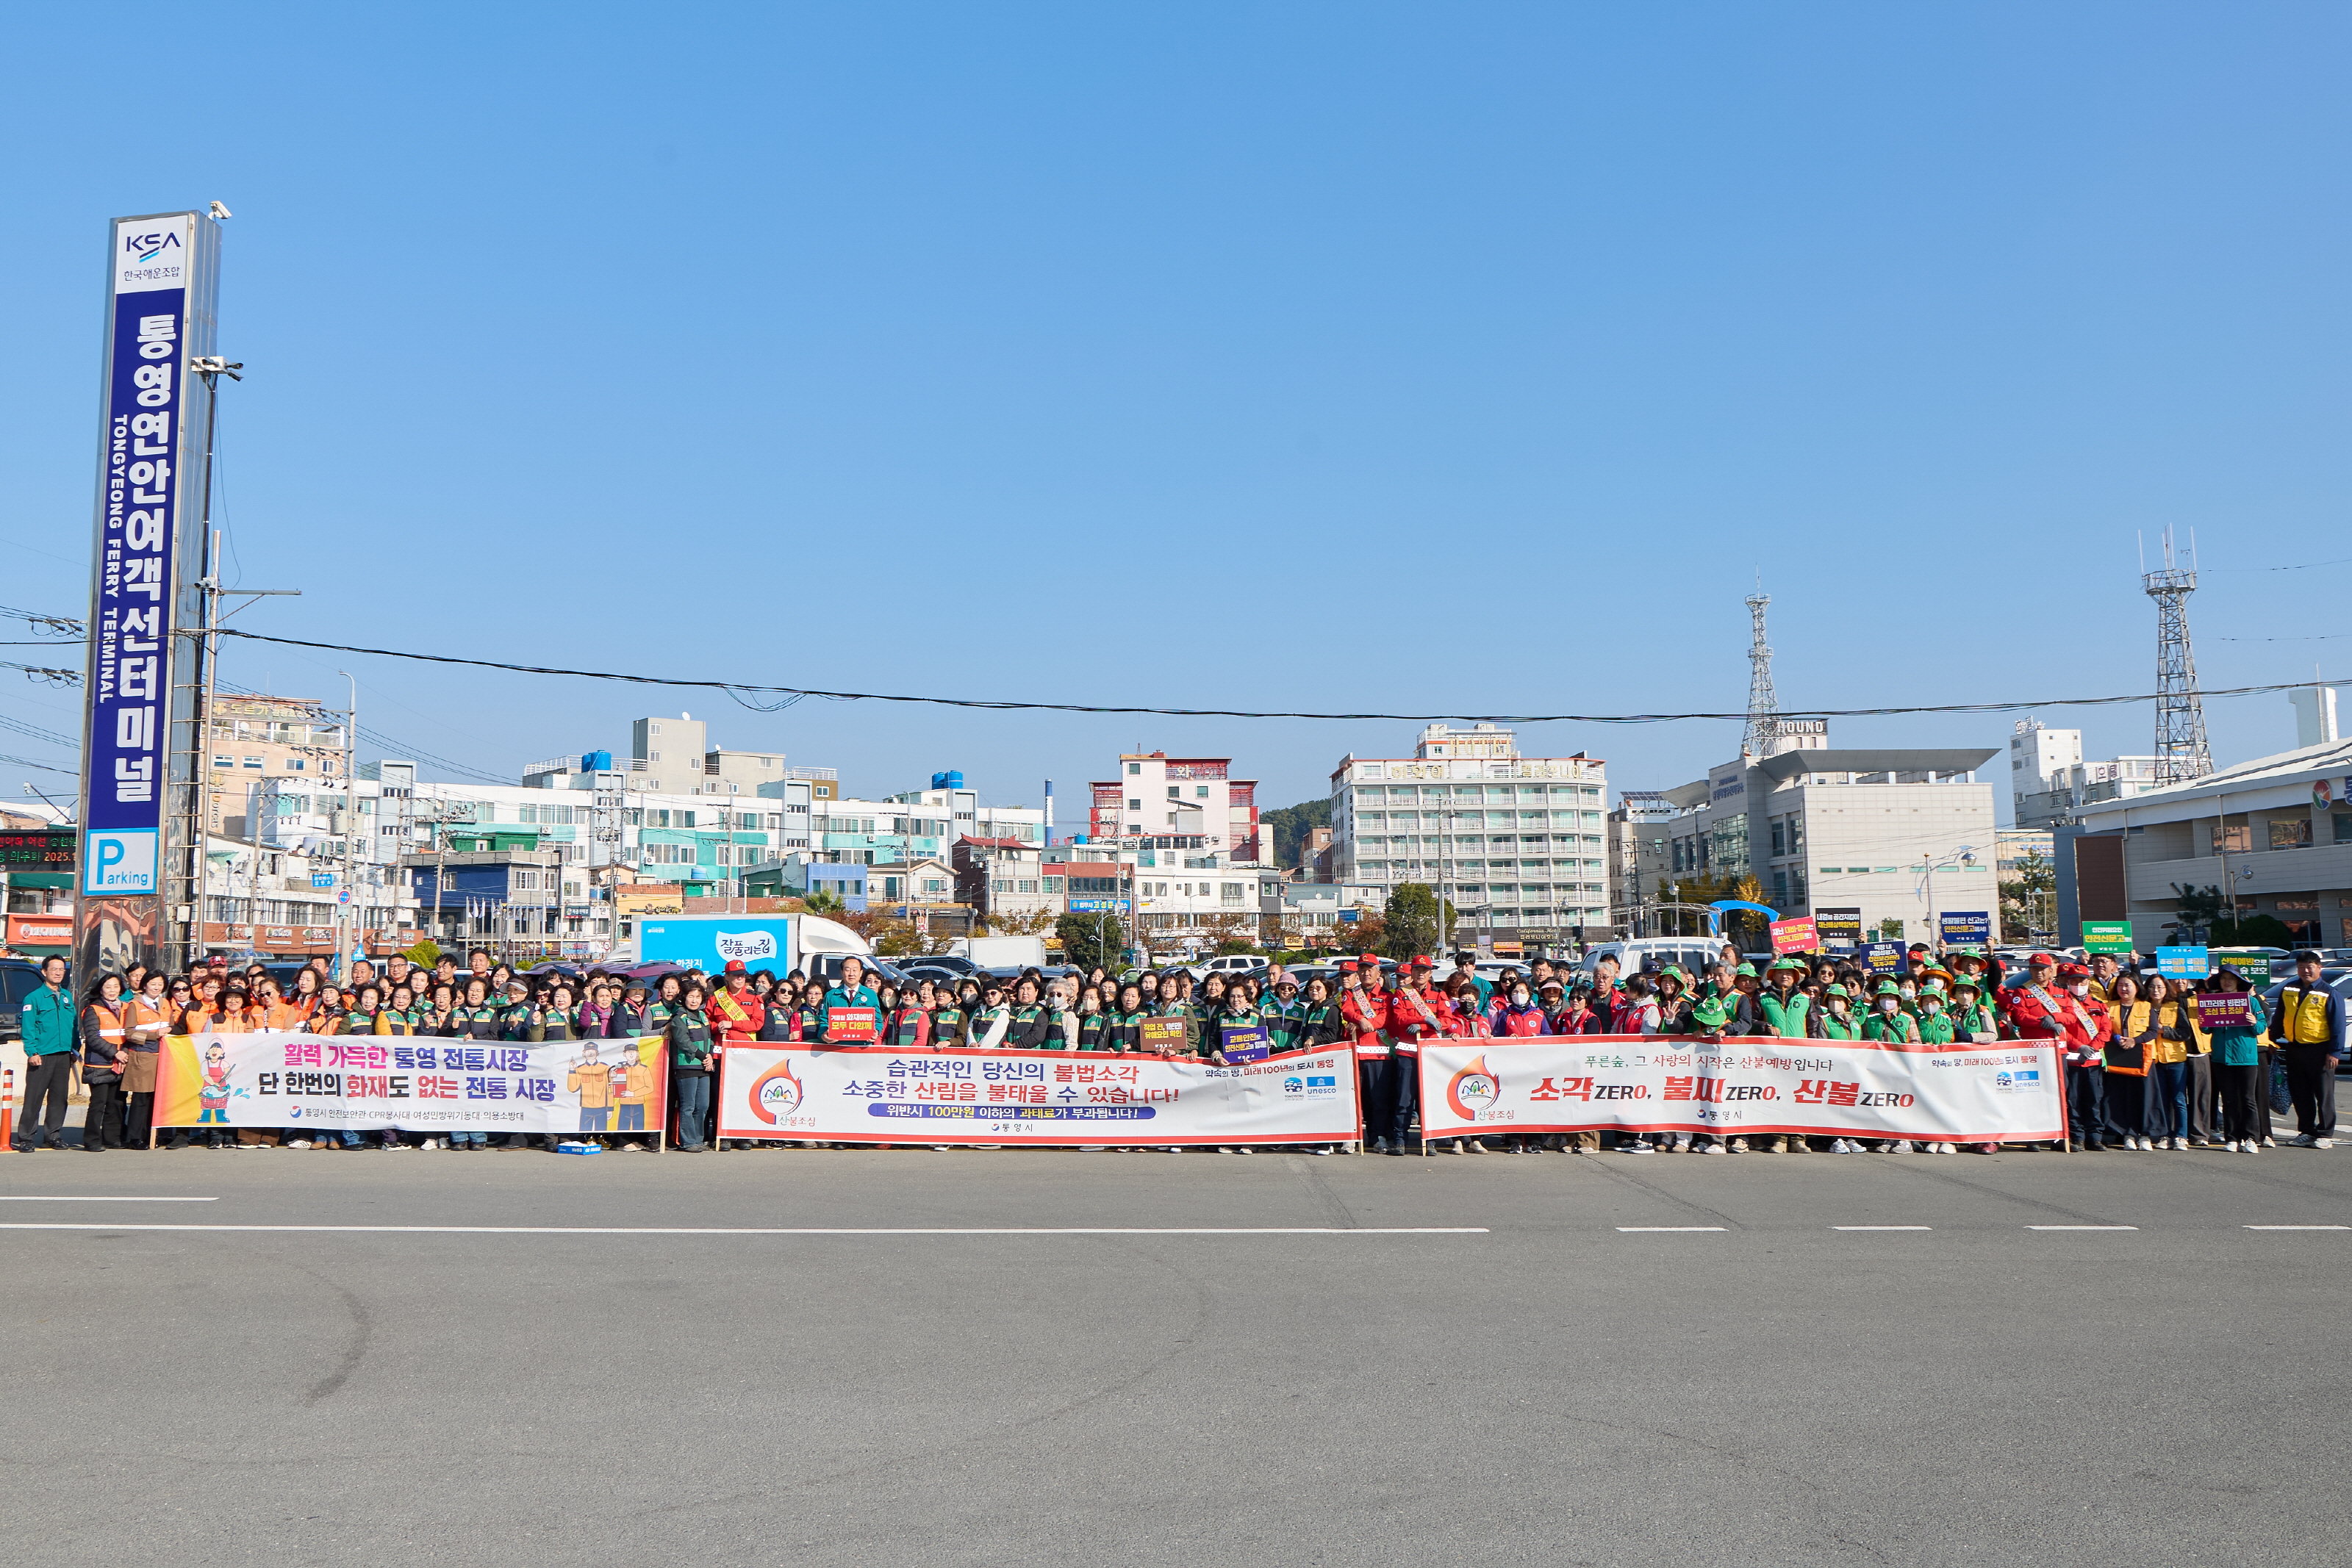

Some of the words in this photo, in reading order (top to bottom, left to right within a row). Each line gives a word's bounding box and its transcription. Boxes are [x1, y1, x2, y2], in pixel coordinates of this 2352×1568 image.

[126, 232, 181, 252] KSA
[124, 266, 180, 281] 한국해운조합
[109, 414, 127, 529] TONGYEONG
[115, 314, 176, 802] 통영연안여객선터미널
[105, 539, 121, 598] FERRY
[100, 608, 117, 703] TERMINAL
[231, 704, 268, 715] 도르가
[1449, 737, 1516, 756] HOTEL
[1391, 765, 1445, 778] 하와이
[27, 836, 46, 847] 어선
[10, 851, 40, 863] 의무화
[96, 839, 148, 886] Parking
[720, 938, 770, 956] 잘풀리는집
[676, 958, 702, 968] 화장지
[2221, 957, 2267, 965] 산불예방으로
[2199, 999, 2226, 1008] 미끄러운
[2227, 999, 2248, 1007] 빙판길
[831, 1021, 847, 1029] 모두
[849, 1021, 872, 1029] 다함께
[1144, 1031, 1169, 1039] 유해요인
[1230, 1033, 1261, 1043] 교통안전도
[1225, 1043, 1254, 1053] 안전신문고와
[1255, 1041, 1266, 1049] 함께!
[284, 1043, 321, 1068] 활력
[329, 1046, 388, 1068] 가득한
[395, 1047, 437, 1069] 통영
[444, 1048, 528, 1072] 전통시장
[1585, 1056, 1628, 1068] 푸른숲,
[1634, 1056, 1648, 1066] 그
[1652, 1054, 1691, 1068] 사랑의
[1696, 1055, 1735, 1070] 시작은
[1740, 1056, 1834, 1072] 산불예방입니다
[1932, 1060, 1952, 1068] 약속의
[1954, 1059, 1962, 1067] 땅,
[2005, 1056, 2019, 1064] 도시
[886, 1059, 972, 1079] 습관적인
[982, 1062, 1044, 1082] 당신의
[1053, 1064, 1139, 1084] 불법소각
[1205, 1069, 1228, 1078] 약속의
[1231, 1069, 1242, 1078] 땅,
[1297, 1061, 1314, 1070] 도시
[1316, 1059, 1334, 1068] 통영
[259, 1073, 279, 1095] 단
[285, 1072, 341, 1096] 한번의
[347, 1074, 409, 1098] 화재도
[418, 1075, 459, 1099] 없는
[466, 1076, 506, 1100] 전통
[515, 1079, 556, 1101] 시장
[842, 1080, 907, 1099] 소중한
[914, 1082, 978, 1101] 산림을
[986, 1084, 1049, 1103] 불태울
[1057, 1086, 1078, 1103] 수
[1087, 1086, 1179, 1104] 있습니다!
[305, 1108, 326, 1118] 통영시
[886, 1105, 922, 1117] 위반시
[928, 1106, 975, 1118] 100만원
[980, 1107, 1015, 1118] 이하의
[1019, 1108, 1067, 1119] 과태료가
[1072, 1107, 1138, 1119] 부과됩니다!
[1478, 1110, 1514, 1121] 산불조심
[1709, 1110, 1742, 1121] 통영시
[779, 1116, 816, 1126] 산불조심
[1002, 1123, 1033, 1132] 통영시
